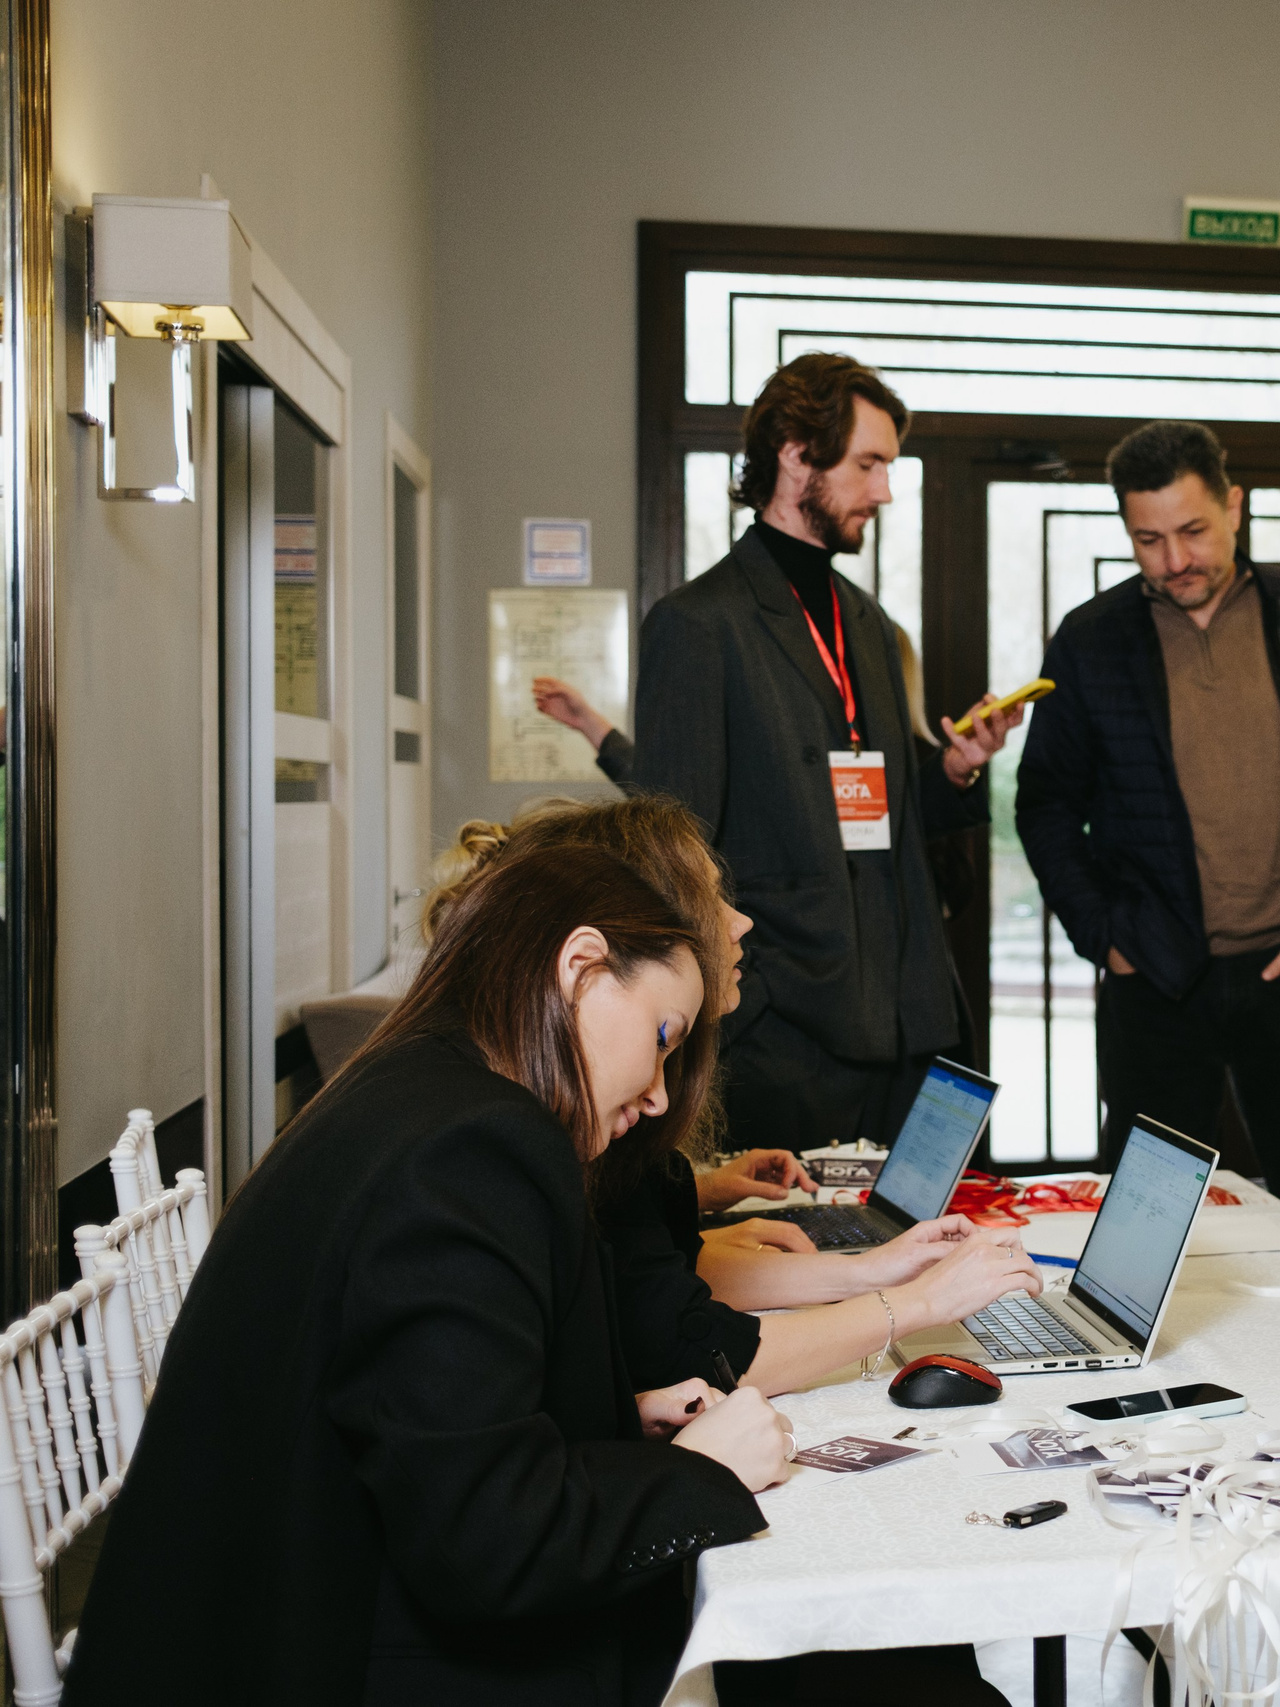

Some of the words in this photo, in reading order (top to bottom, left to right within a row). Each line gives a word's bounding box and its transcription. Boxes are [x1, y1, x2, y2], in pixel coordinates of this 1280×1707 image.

[836, 783, 872, 799] ЮГА
[823, 1165, 871, 1177] ЮГА
[810, 1444, 871, 1461] ЮГА
[1031, 1439, 1068, 1459] ЮГА
